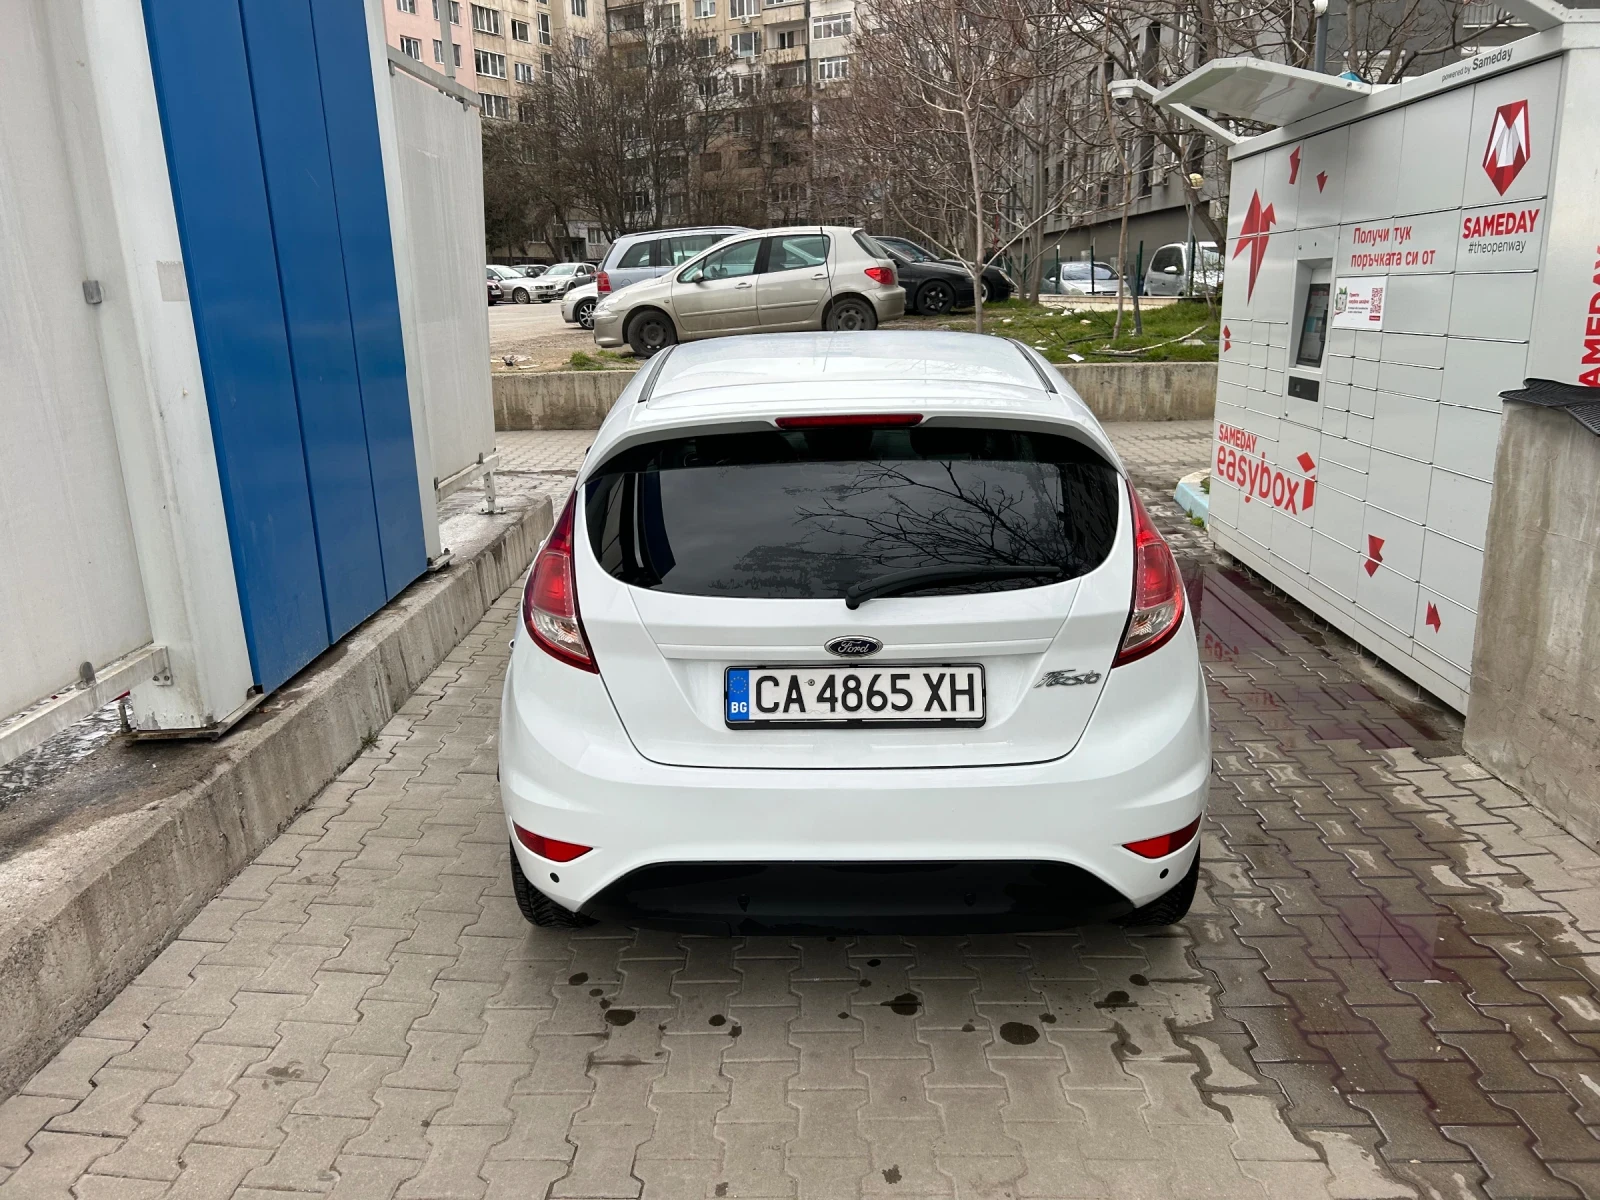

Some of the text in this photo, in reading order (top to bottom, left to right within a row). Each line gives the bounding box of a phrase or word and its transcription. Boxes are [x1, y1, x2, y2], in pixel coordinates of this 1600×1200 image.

[1441, 48, 1514, 83] powered by Sameday
[1353, 225, 1412, 247] Получи тук
[1462, 208, 1540, 239] SAMEDAY
[1351, 249, 1436, 271] поръчката си от
[1468, 239, 1527, 255] #theopenway
[1218, 423, 1258, 454] SAMEDAY
[1217, 445, 1298, 516] easybox
[837, 640, 871, 654] Ford
[755, 672, 975, 713] CA 4865 XH
[731, 702, 748, 714] BG
